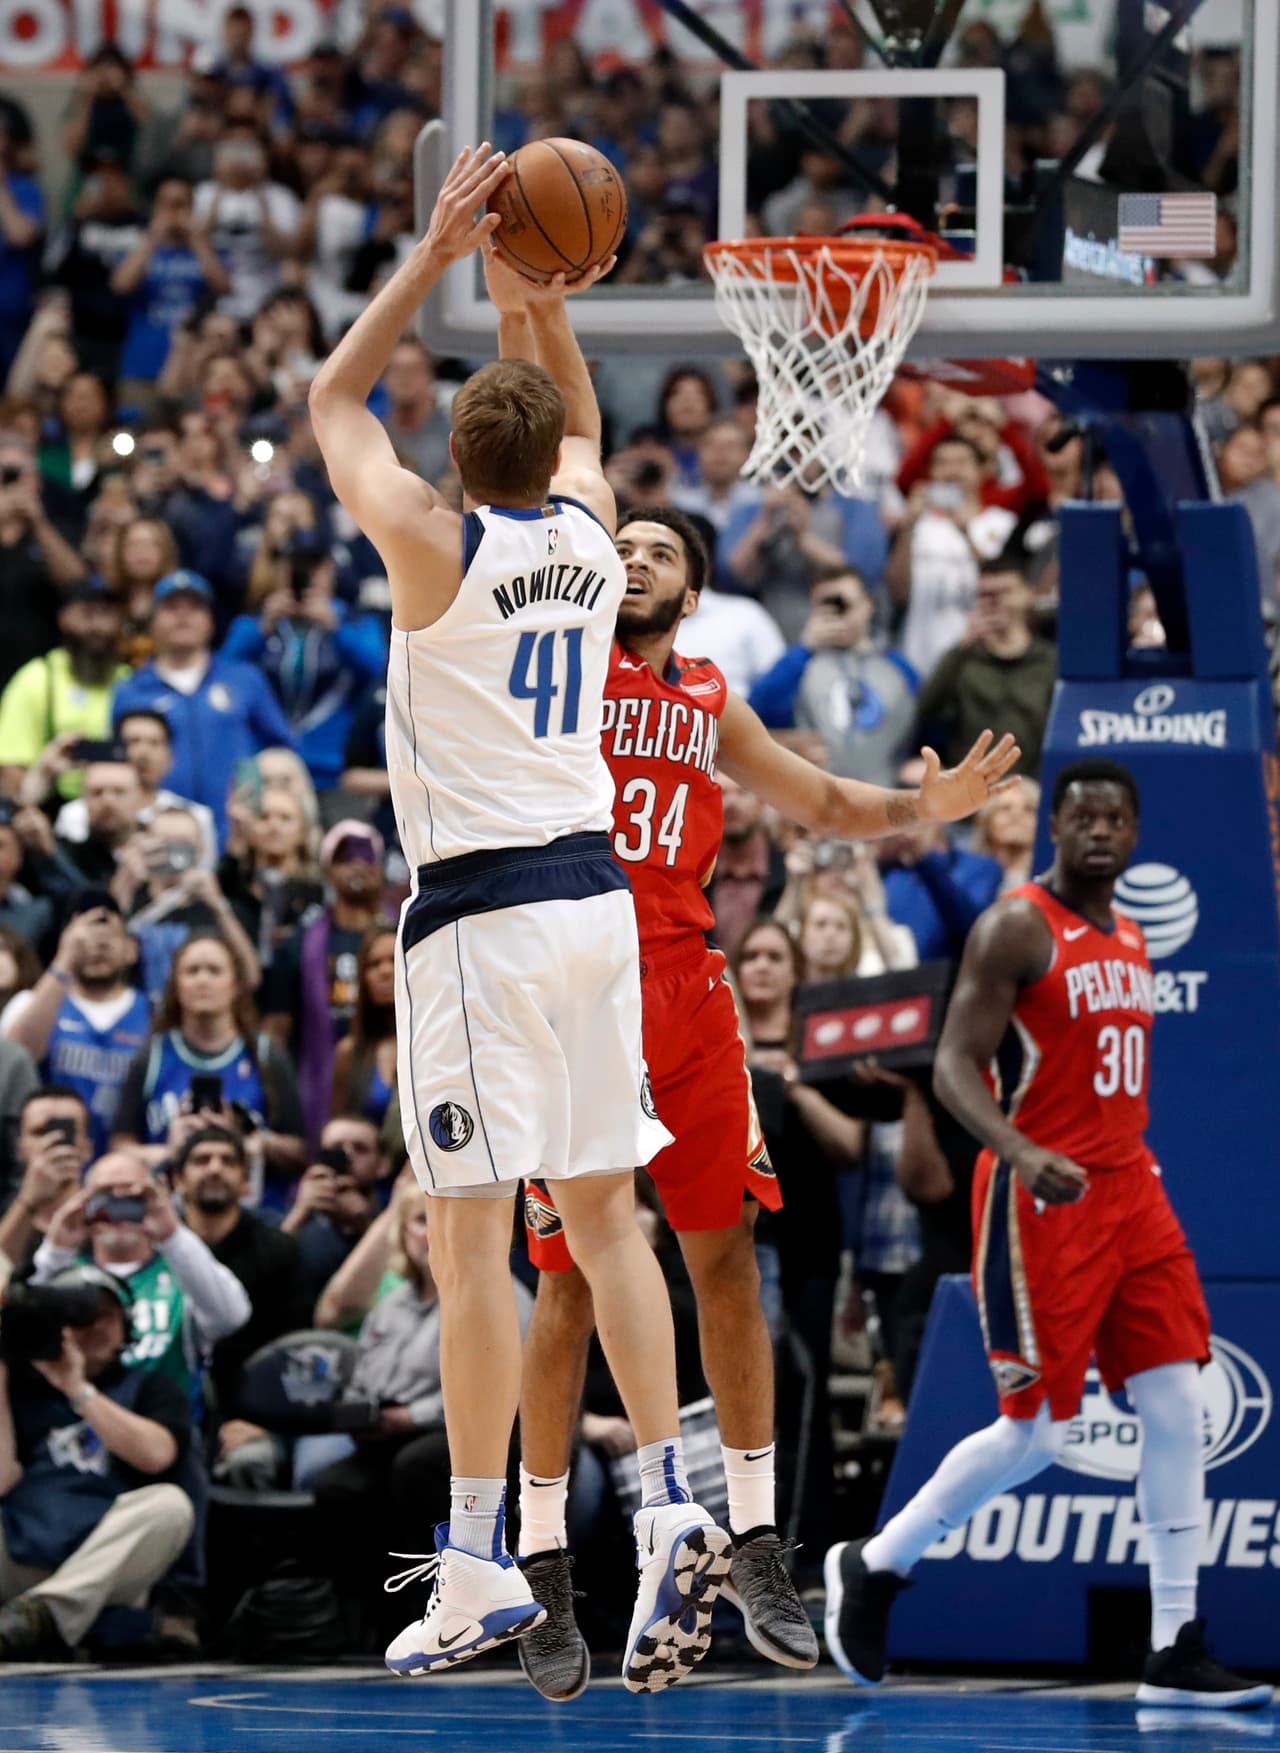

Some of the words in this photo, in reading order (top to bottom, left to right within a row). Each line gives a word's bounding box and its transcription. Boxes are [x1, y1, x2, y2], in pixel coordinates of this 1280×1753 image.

[492, 564, 606, 620] NOWITZKI
[508, 627, 584, 738] 41
[601, 697, 718, 783] PELICAN
[1078, 709, 1227, 748] SPALDING
[613, 777, 690, 867] 34
[1153, 970, 1208, 1013] &T
[1093, 1024, 1145, 1097] 30
[922, 1493, 1280, 1567] OUTHE
